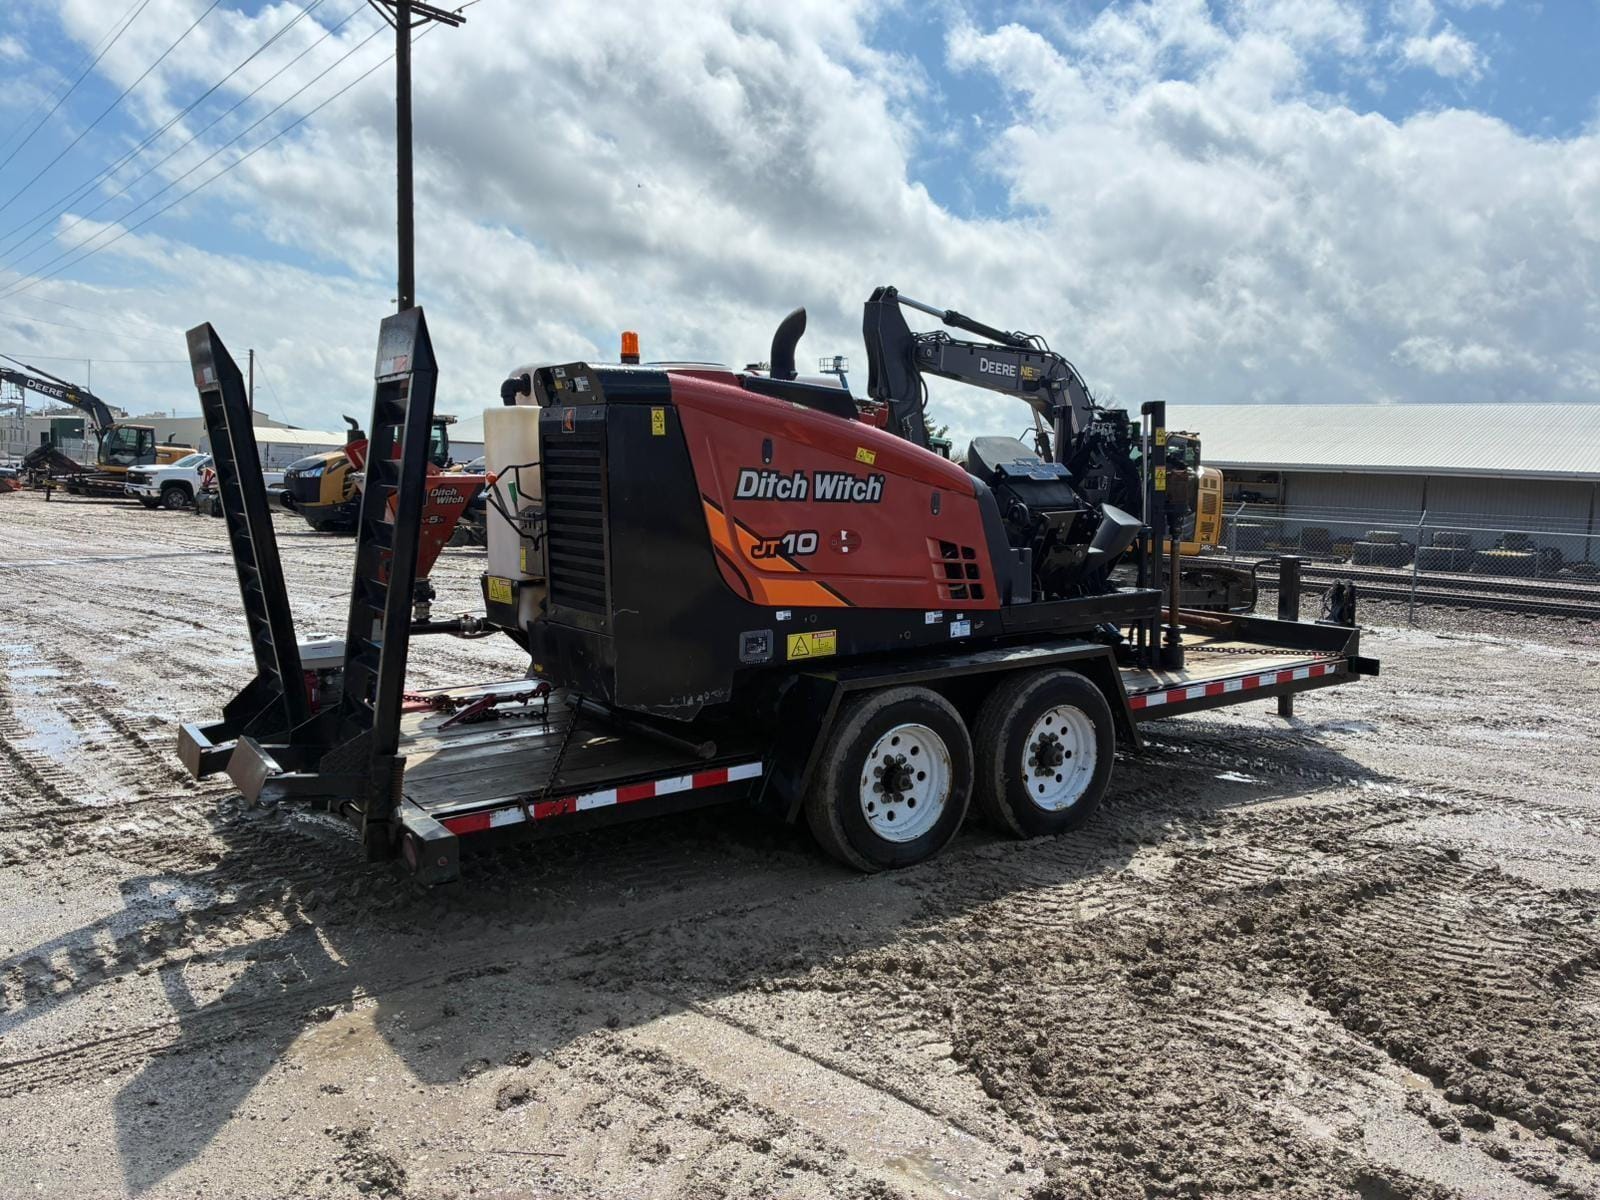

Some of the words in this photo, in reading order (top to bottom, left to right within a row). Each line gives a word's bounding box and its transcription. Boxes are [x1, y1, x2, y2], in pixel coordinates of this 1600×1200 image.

[980, 357, 1016, 377] DEERE
[26, 379, 64, 397] DEERE
[430, 488, 457, 497] Ditch
[736, 470, 808, 499] Ditch
[814, 473, 881, 500] Witch
[436, 495, 464, 505] Witch
[753, 531, 818, 556] JT10
